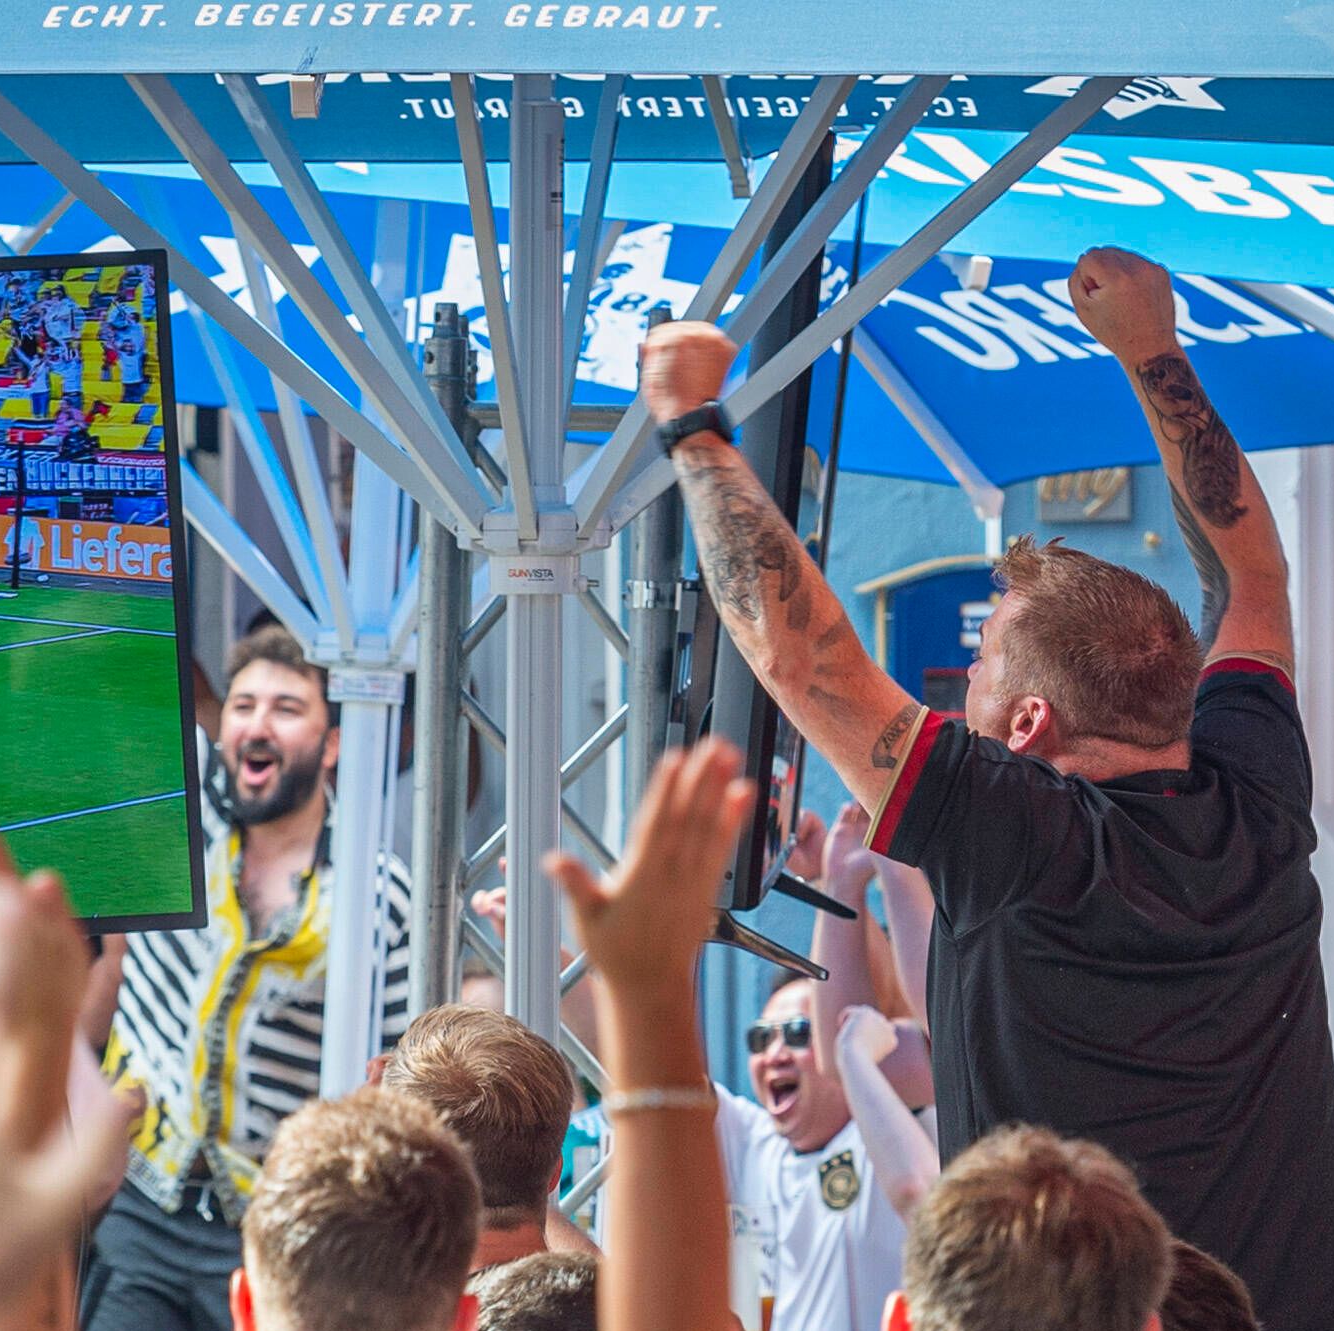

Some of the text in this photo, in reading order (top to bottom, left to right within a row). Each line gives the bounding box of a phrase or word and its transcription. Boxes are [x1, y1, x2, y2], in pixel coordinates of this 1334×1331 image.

[43, 3, 724, 29] ECHT. BEGEISTERT. GEBRAUT.
[507, 568, 555, 578] SUNVISTA
